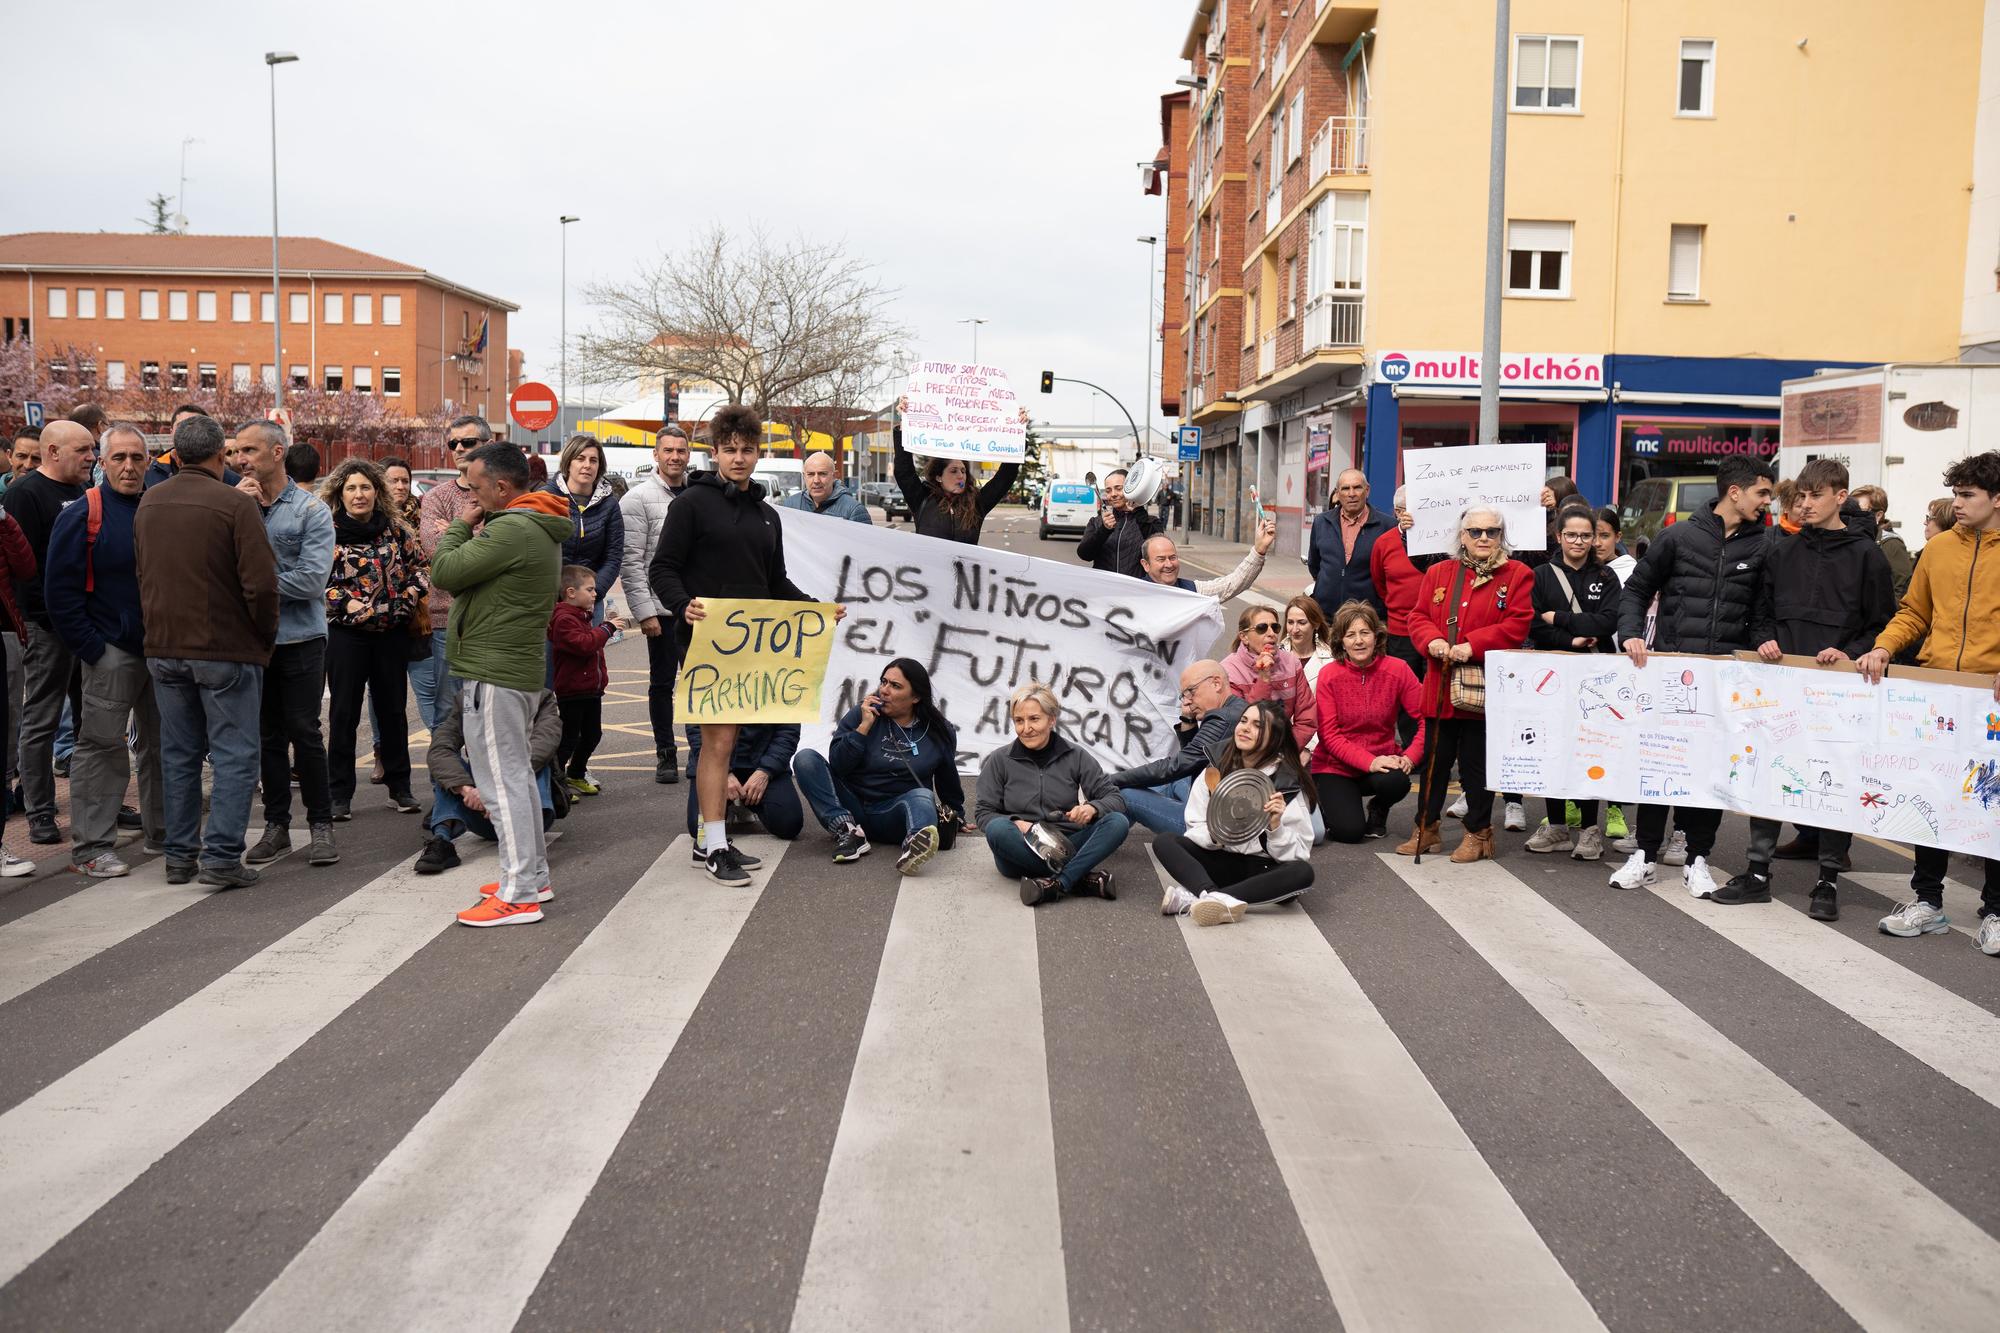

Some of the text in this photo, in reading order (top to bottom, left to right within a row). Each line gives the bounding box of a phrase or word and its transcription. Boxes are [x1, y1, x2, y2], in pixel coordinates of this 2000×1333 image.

[923, 362, 956, 375] FUTURO
[961, 364, 977, 375] SON
[1386, 355, 1600, 381] mc multolchón
[907, 382, 921, 393] EL
[926, 382, 982, 397] PRESENTE
[945, 396, 1003, 411] MAYORES.
[906, 402, 940, 415] ELLOS
[947, 412, 999, 424] MERECEN
[908, 421, 953, 432] ESPACIO
[1635, 439, 1659, 452] mc
[1415, 462, 1533, 480] ZONA DE APARCAMIENTO
[1417, 497, 1451, 510] ZONA
[834, 554, 929, 604] LOS
[711, 609, 825, 658] STOP
[843, 617, 897, 657] EL
